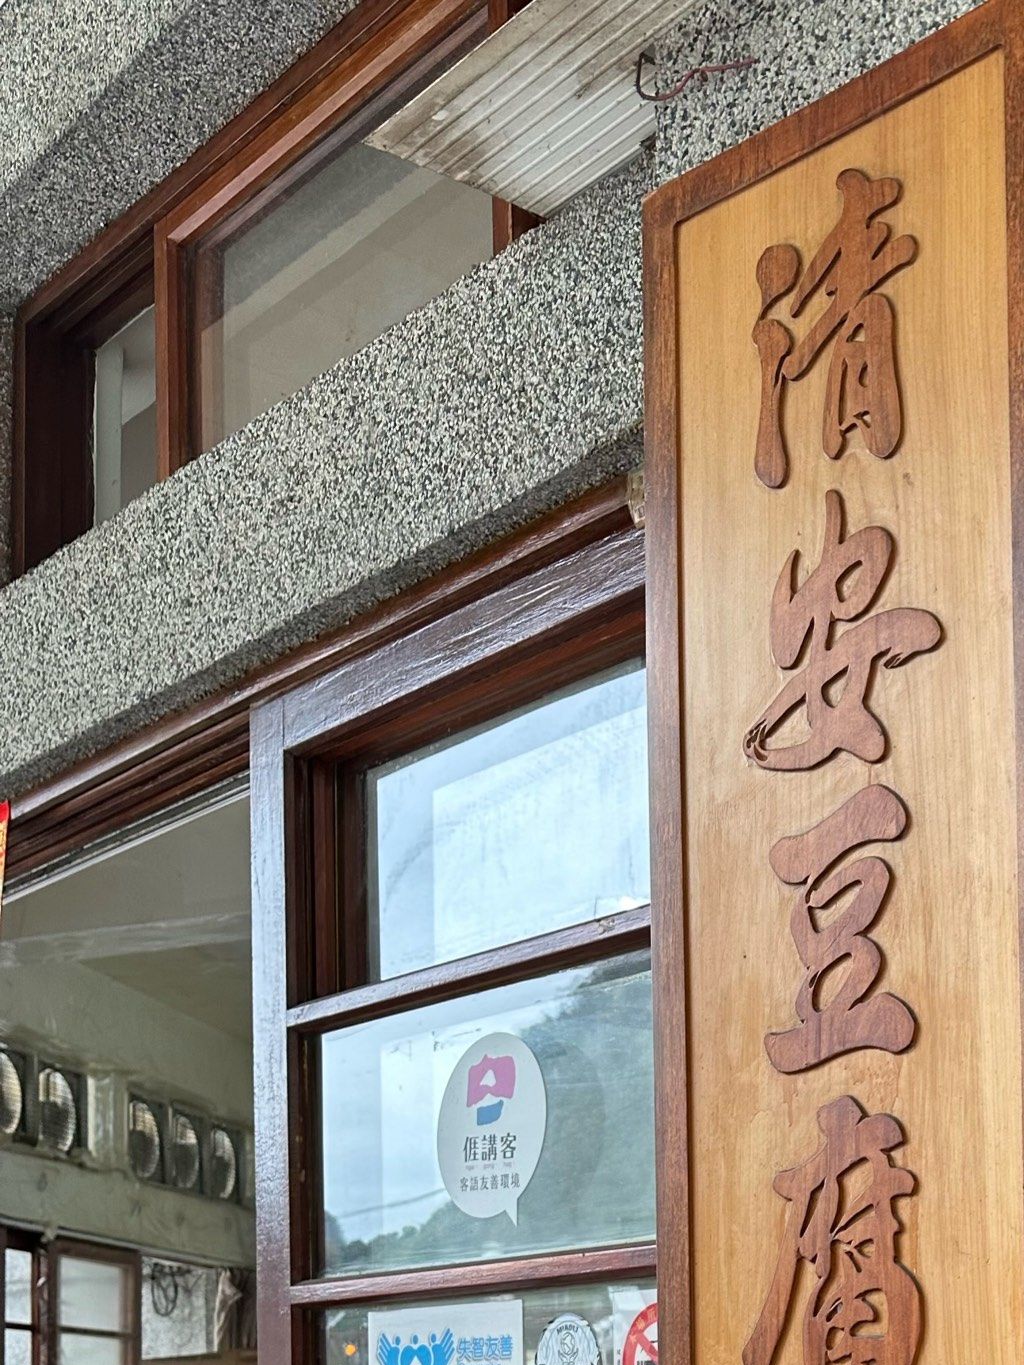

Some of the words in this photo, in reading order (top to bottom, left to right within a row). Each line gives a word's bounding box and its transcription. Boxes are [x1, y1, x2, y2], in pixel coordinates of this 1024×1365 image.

[460, 1173, 521, 1192] 客語友善環境
[458, 1335, 513, 1360] 失智友善
